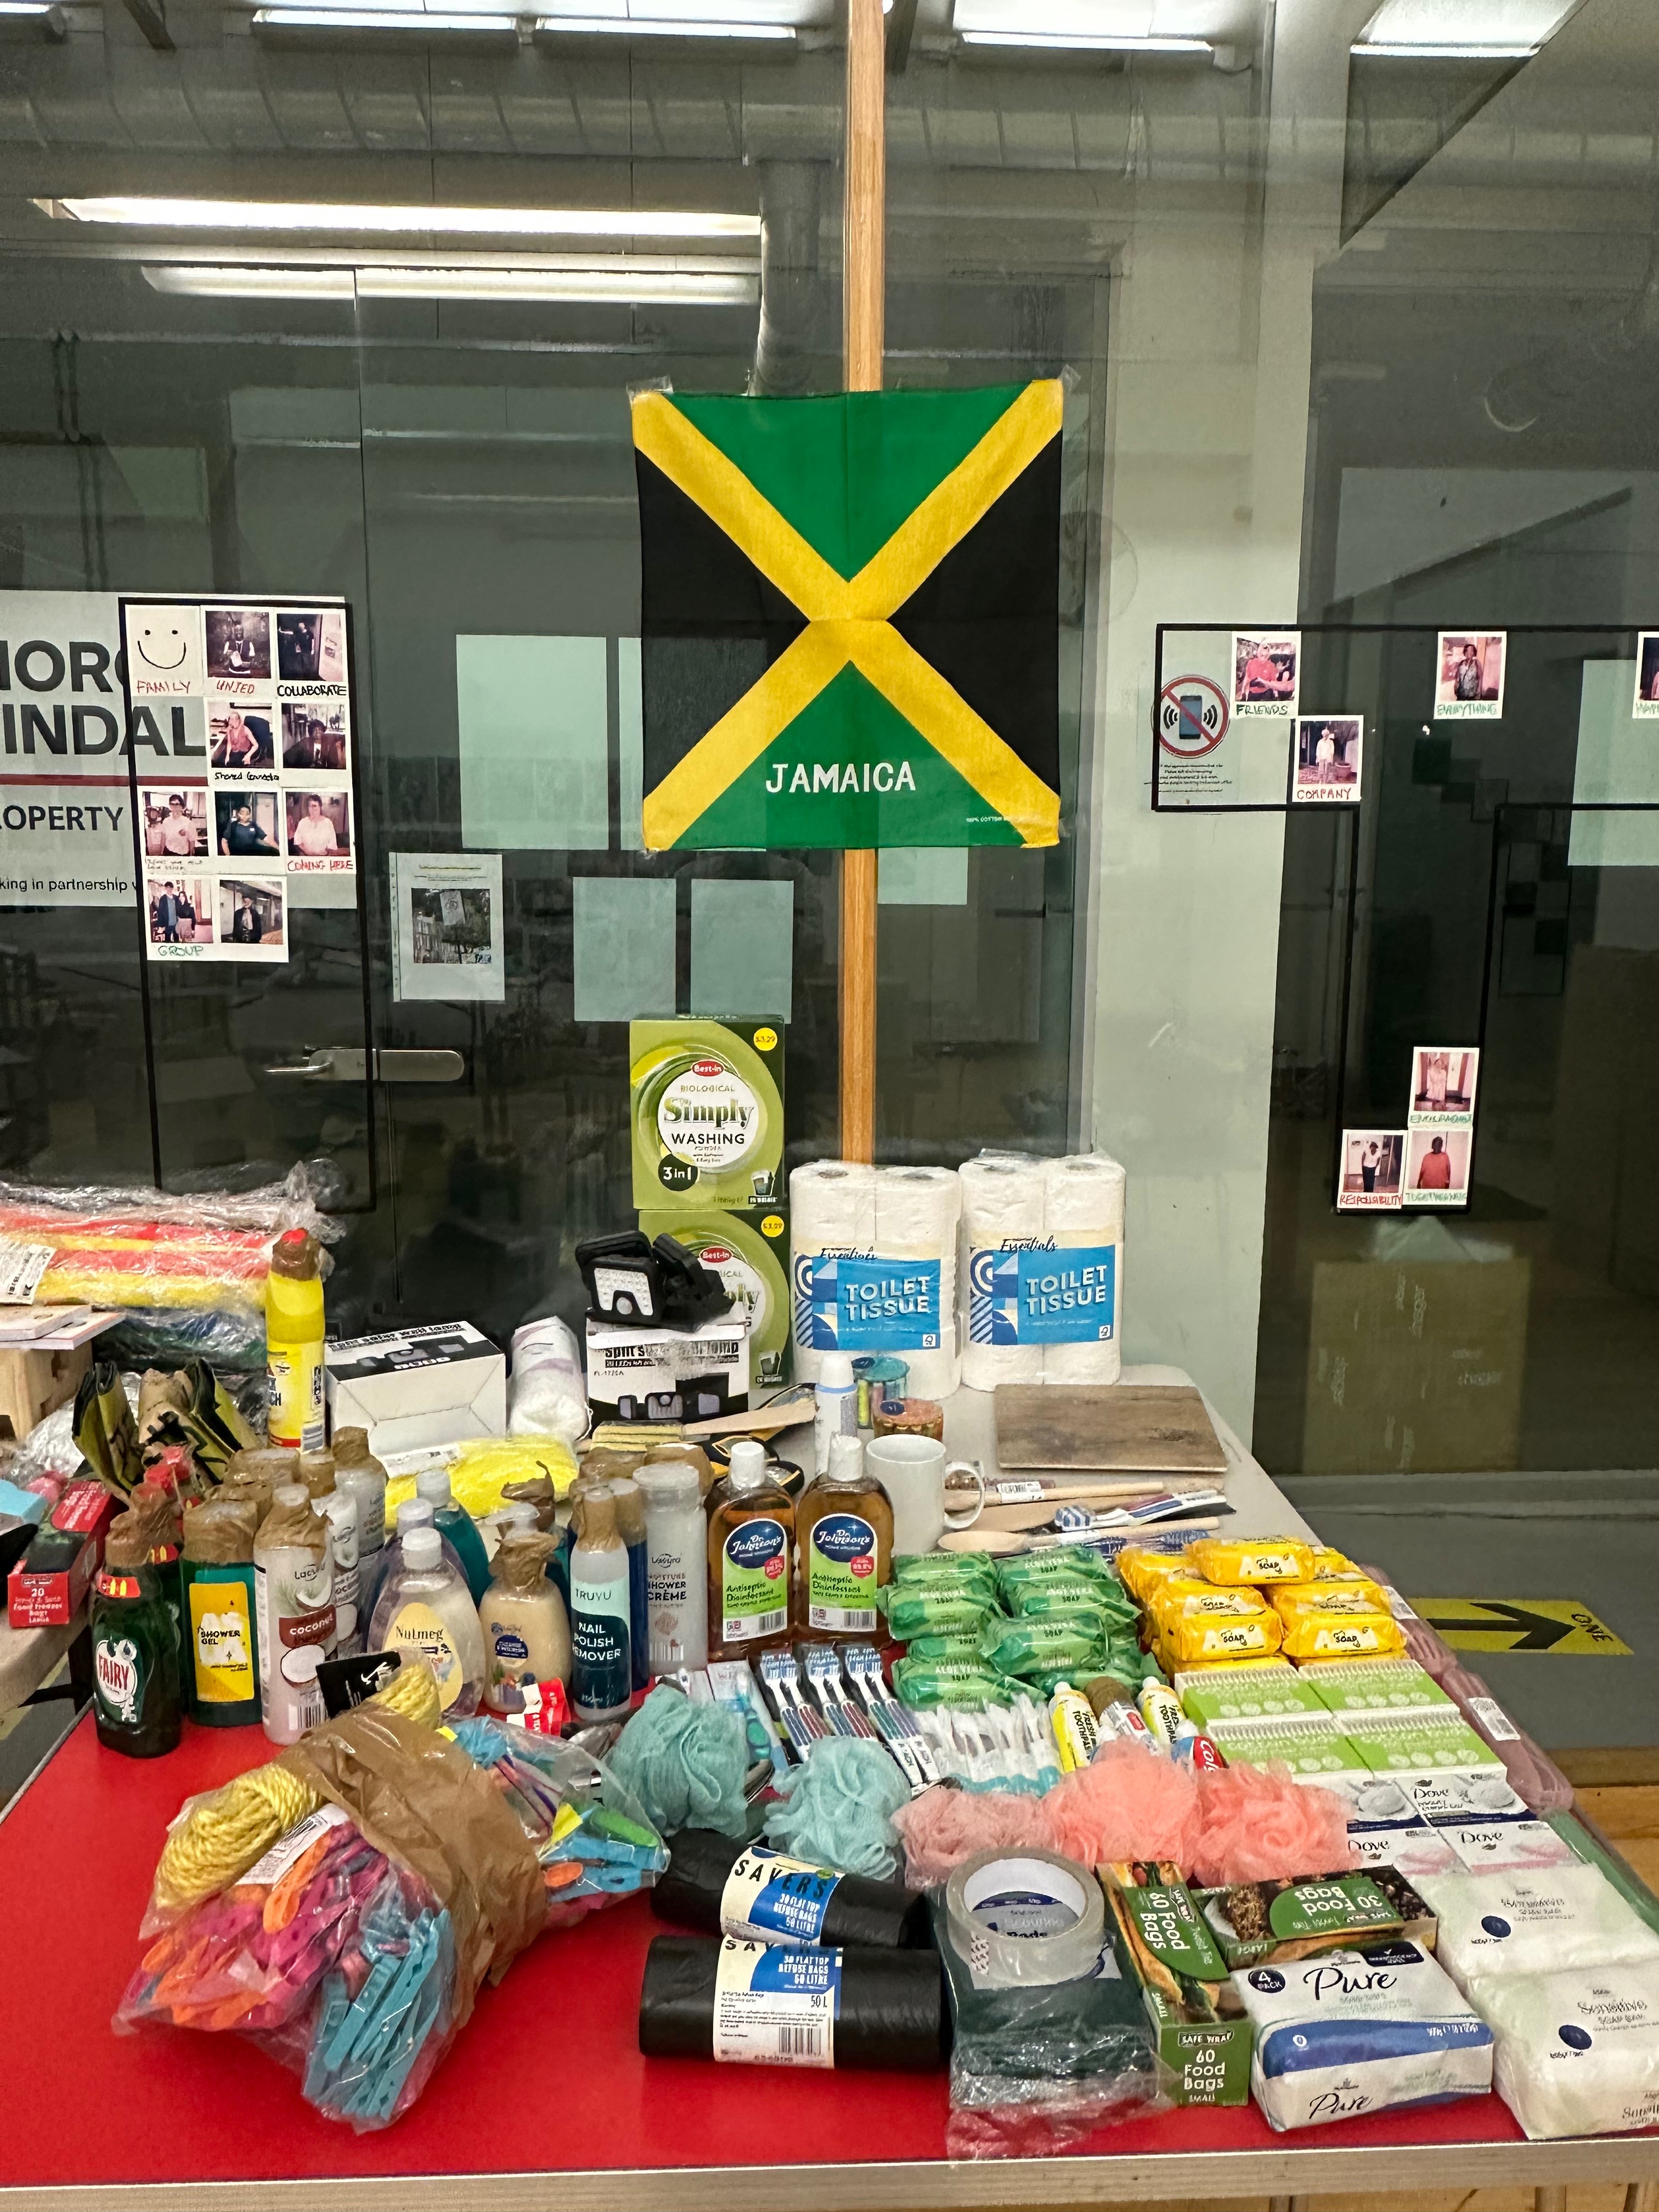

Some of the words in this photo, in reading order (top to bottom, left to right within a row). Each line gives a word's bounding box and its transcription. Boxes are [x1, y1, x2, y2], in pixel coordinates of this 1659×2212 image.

[0, 640, 125, 692] OR
[137, 680, 191, 693] FAMILY
[276, 685, 347, 697] COLLABORATE
[1236, 703, 1289, 715] FRIENDS
[765, 761, 916, 794] JAMAICA
[1297, 787, 1352, 800] COMPANY
[0, 805, 123, 831] OPERTY
[32, 877, 44, 889] in
[49, 877, 127, 892] partnership
[157, 945, 204, 957] GROUP
[680, 1085, 736, 1093] BIOLOGICAL
[663, 1097, 754, 1129] Simply
[671, 1133, 746, 1145] WASHING
[1025, 1265, 1108, 1295] TOILET
[845, 1276, 931, 1302] TOILET
[1026, 1284, 1107, 1316] TISSUE
[845, 1295, 932, 1322] TISSUE
[730, 1536, 782, 1555] Johnson's
[816, 1531, 871, 1545] Johnson's
[200, 1629, 241, 1638] SHOWER
[396, 1625, 445, 1641] Nutmeg
[578, 1622, 607, 1634] NAIL
[574, 1632, 614, 1647] POLISH
[98, 1654, 129, 1691] FAIRY
[1413, 1788, 1449, 1799] Dove
[1457, 1830, 1504, 1844] Dove
[1347, 1839, 1390, 1852] Dove
[734, 1859, 828, 1900] SAVERS
[1149, 1892, 1170, 1909] 60
[1294, 1886, 1347, 1900] Bags
[1301, 1898, 1357, 1917] Food
[1357, 1895, 1384, 1909] 30
[1139, 1912, 1167, 1950] Bags
[1158, 1911, 1190, 1950] Food
[806, 1974, 828, 1985] LITRE
[1303, 1967, 1398, 2001] Pure
[1195, 2049, 1216, 2063] 60
[1184, 2062, 1226, 2077] Food
[1183, 2076, 1224, 2092] Bags
[1308, 2092, 1374, 2120] Pure
